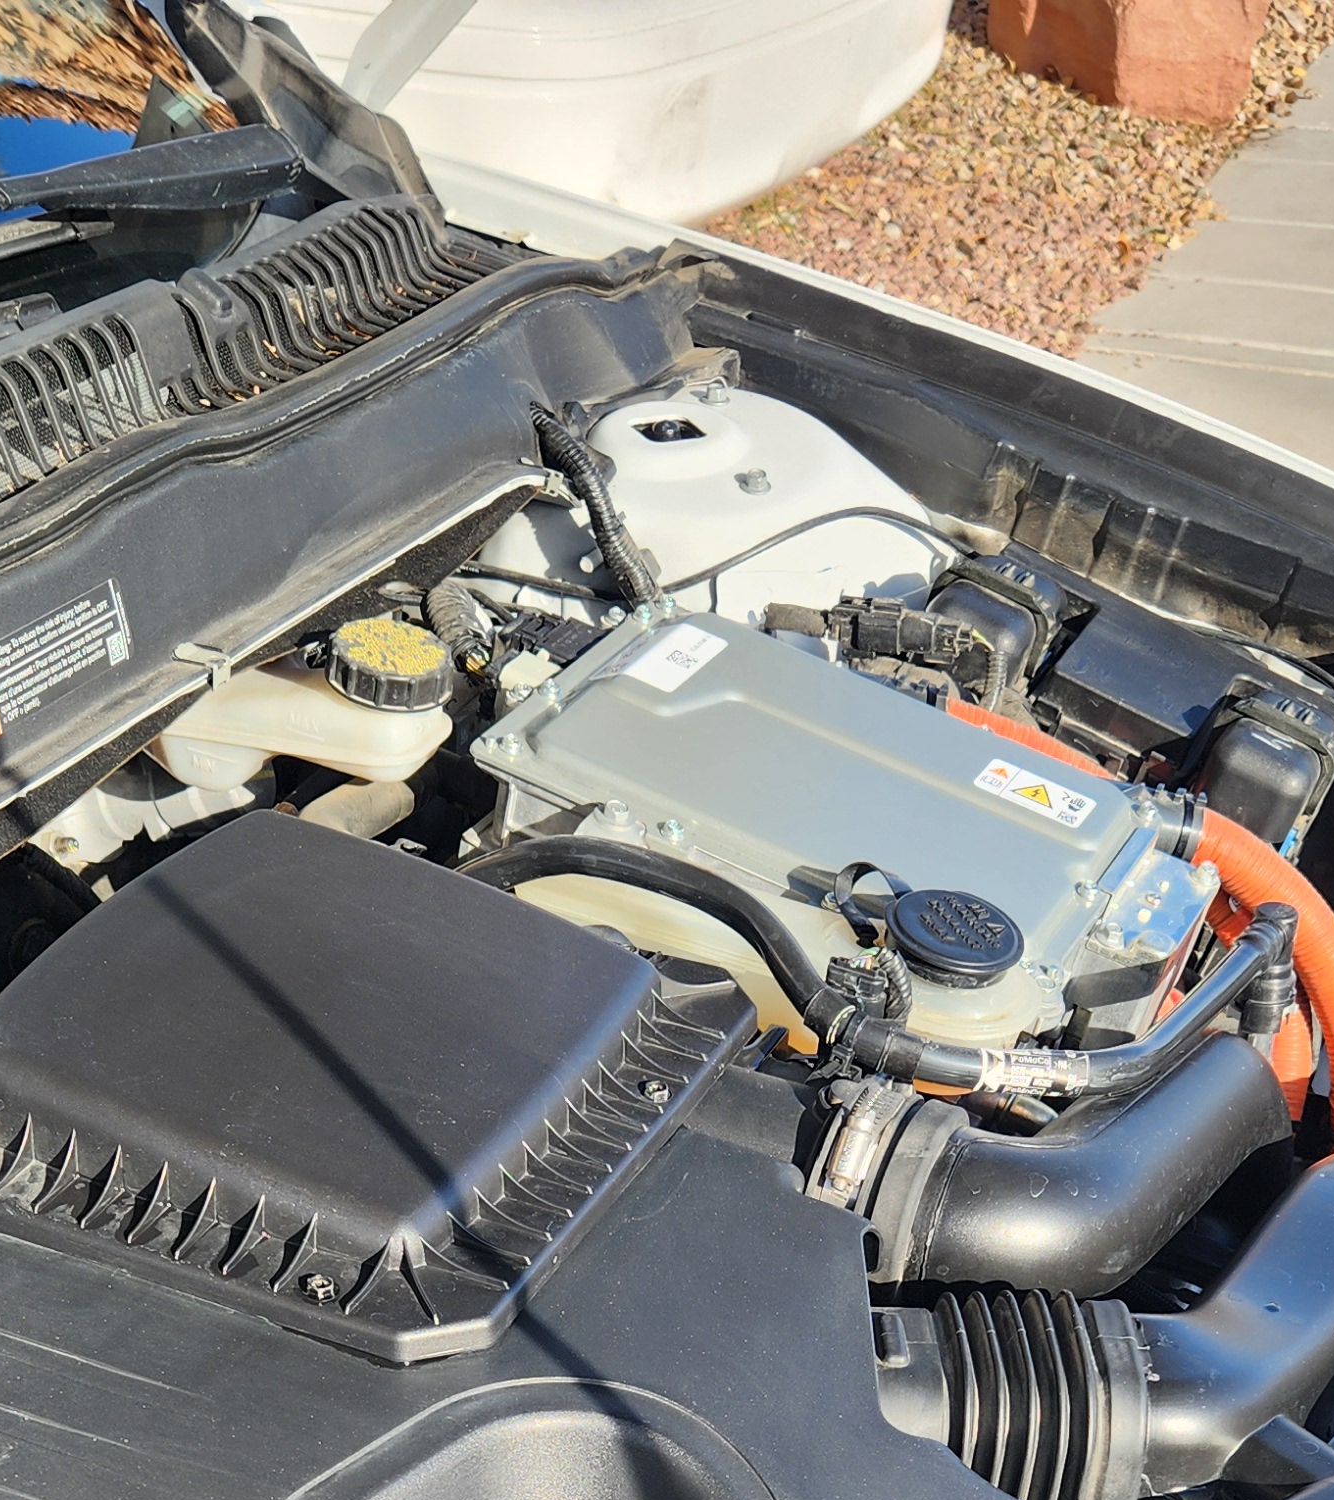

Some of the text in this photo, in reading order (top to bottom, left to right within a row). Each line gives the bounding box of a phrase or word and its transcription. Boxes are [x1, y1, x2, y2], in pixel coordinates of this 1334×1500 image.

[11, 637, 19, 648] To
[18, 627, 36, 645] reduce
[35, 622, 45, 635] the
[44, 617, 54, 630] risk
[53, 614, 60, 625] of
[73, 597, 91, 613] before
[9, 647, 25, 662] under
[57, 619, 75, 635] vehicle
[35, 656, 48, 670] Pour
[289, 711, 320, 735] MAX
[190, 753, 217, 774] MIN
